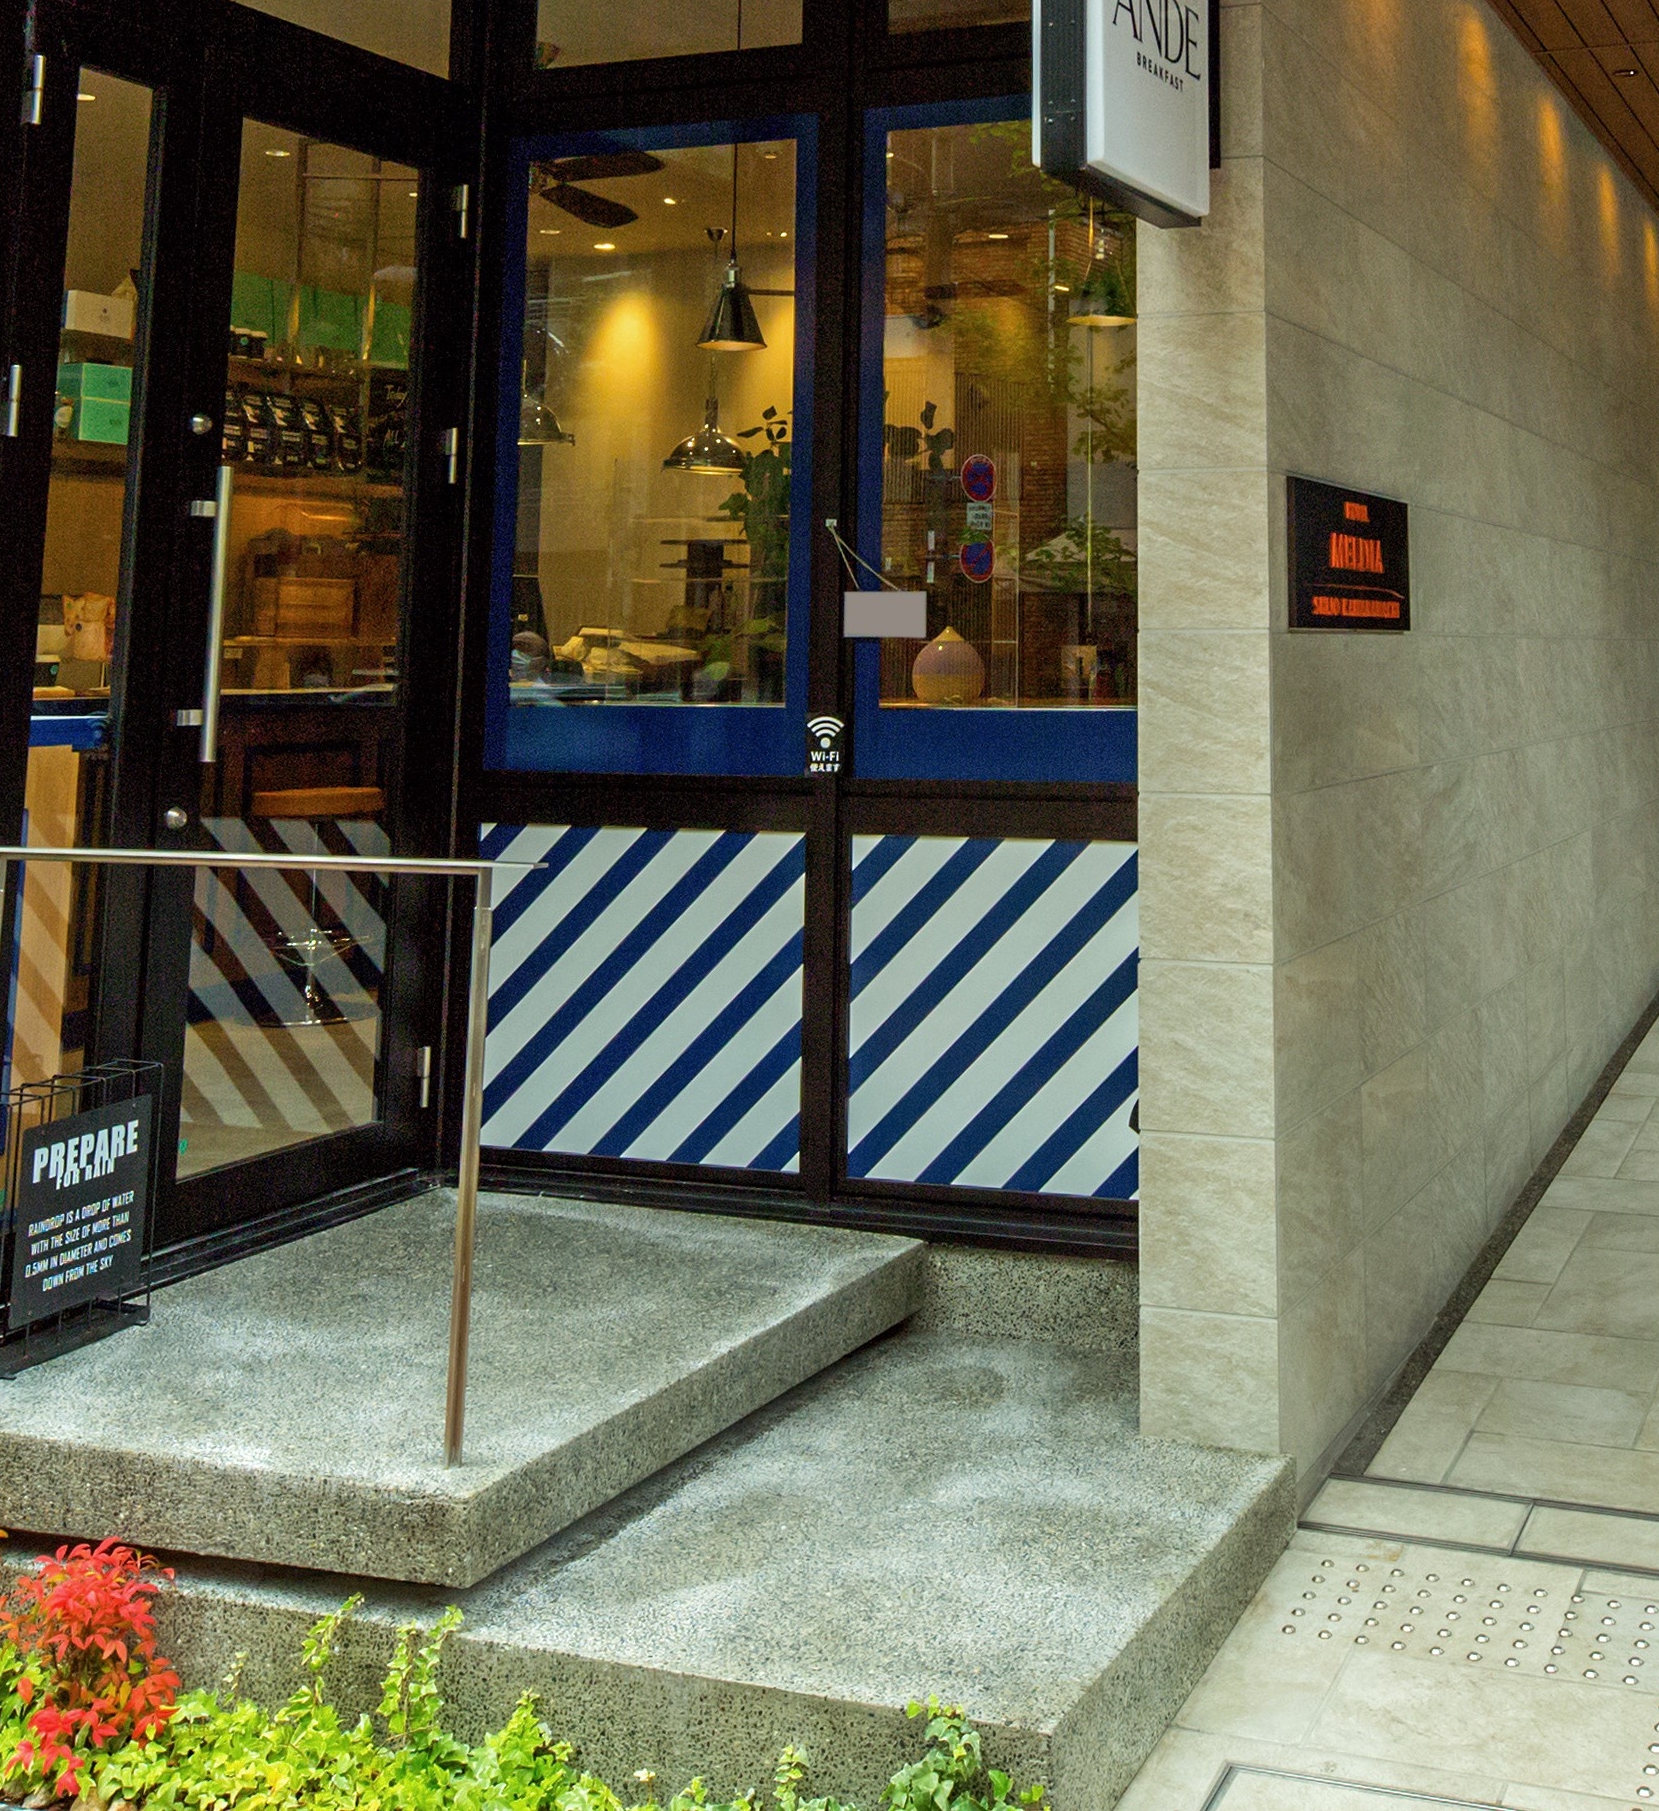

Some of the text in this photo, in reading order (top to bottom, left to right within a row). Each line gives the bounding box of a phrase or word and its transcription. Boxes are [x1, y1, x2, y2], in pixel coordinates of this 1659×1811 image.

[1136, 51, 1185, 93] BREAKFAST
[810, 751, 840, 761] Wi-Fi
[32, 1119, 139, 1185] PREPARE
[56, 1156, 116, 1190] FOR RAIN
[28, 1213, 64, 1238] RAINDROP
[66, 1210, 74, 1224] IS
[75, 1209, 80, 1221] A
[102, 1198, 111, 1212] OF
[112, 1190, 134, 1208] WATER
[31, 1211, 130, 1256] WITH THE SIZE OF MORE THAN
[50, 1255, 58, 1269] IN
[60, 1243, 93, 1266] DIAMETER
[94, 1238, 108, 1254] AND
[109, 1229, 132, 1248] COMES
[42, 1254, 114, 1292] DOWN FROM THE SKY
